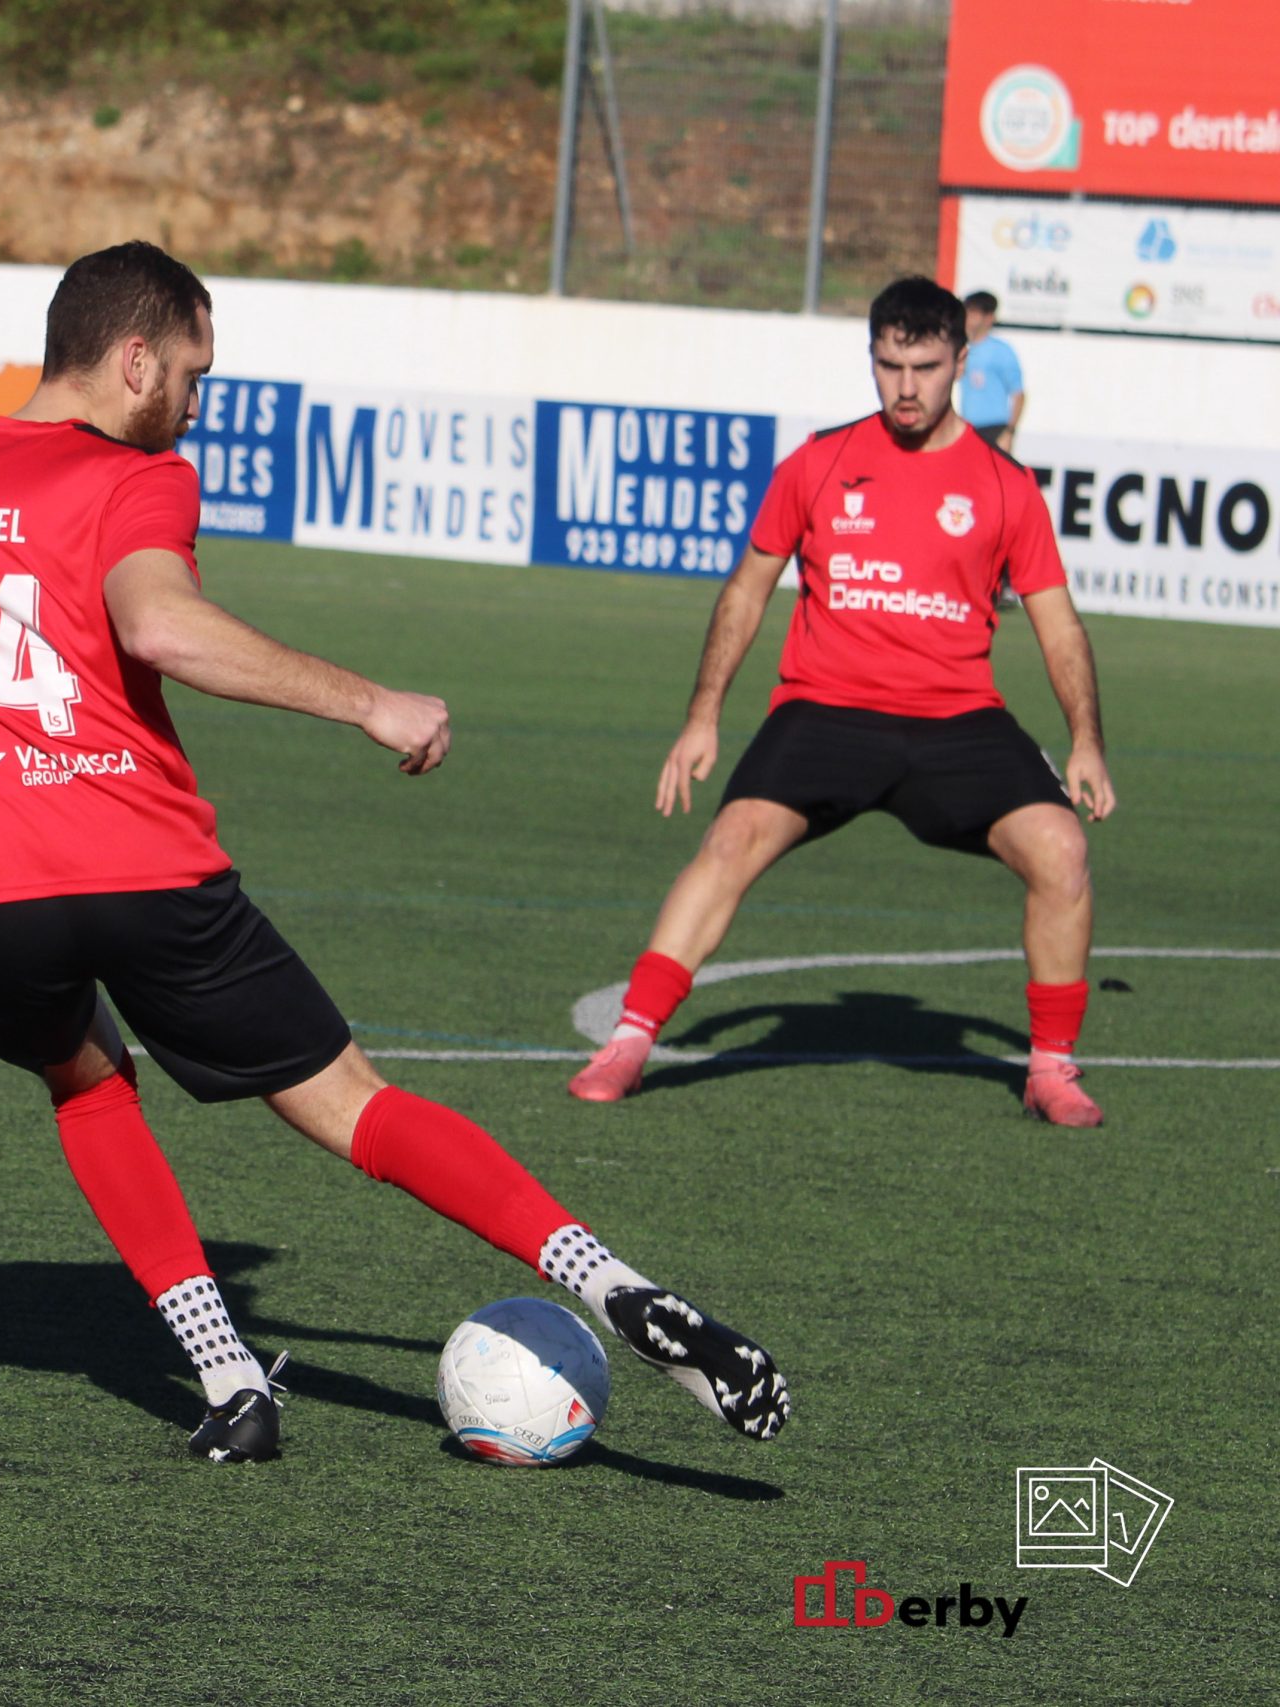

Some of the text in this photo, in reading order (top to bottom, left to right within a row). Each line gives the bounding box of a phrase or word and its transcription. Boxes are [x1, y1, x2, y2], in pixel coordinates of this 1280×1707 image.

[1102, 109, 1160, 147] TOP
[565, 526, 734, 574] 933 589 320
[828, 552, 903, 584] Euro
[21, 770, 74, 787] GROUP
